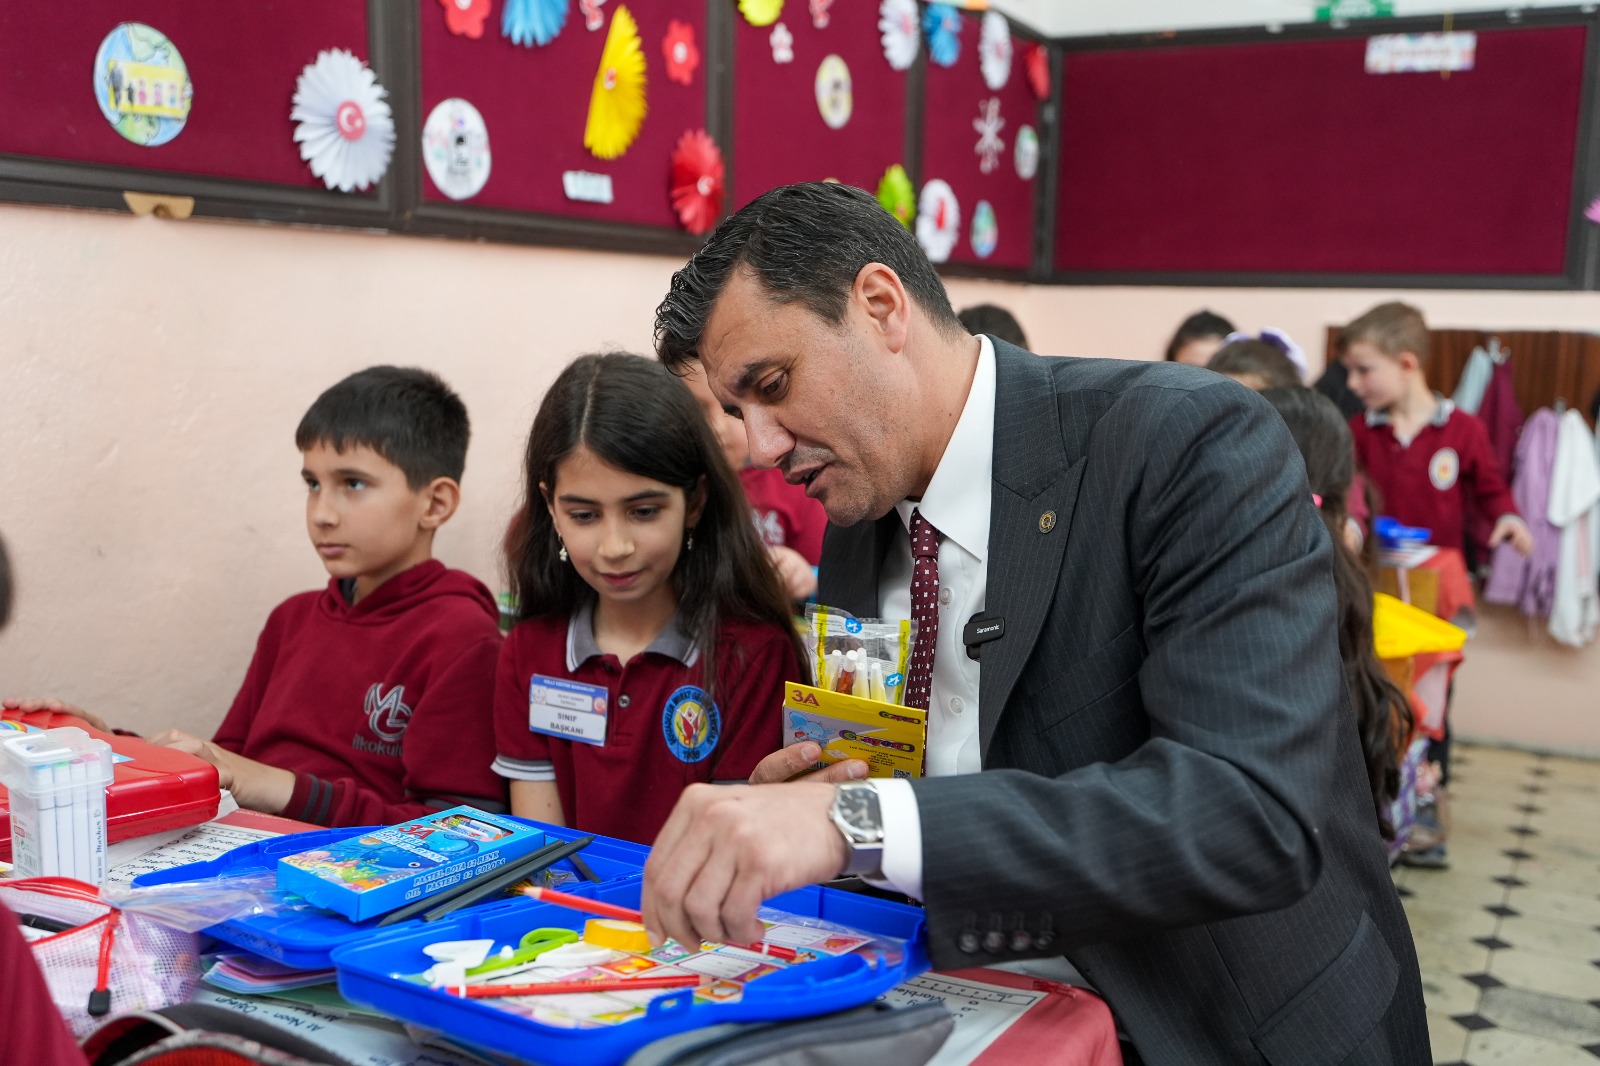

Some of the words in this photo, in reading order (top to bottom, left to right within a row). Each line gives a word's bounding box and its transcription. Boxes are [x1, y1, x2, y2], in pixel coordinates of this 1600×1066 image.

[791, 690, 819, 706] 3A
[398, 824, 435, 840] 3A
[413, 869, 446, 887] PASTEL
[445, 861, 467, 876] BOYA
[477, 850, 500, 863] RENK
[405, 889, 422, 900] OIL
[425, 874, 461, 893] PASTELS
